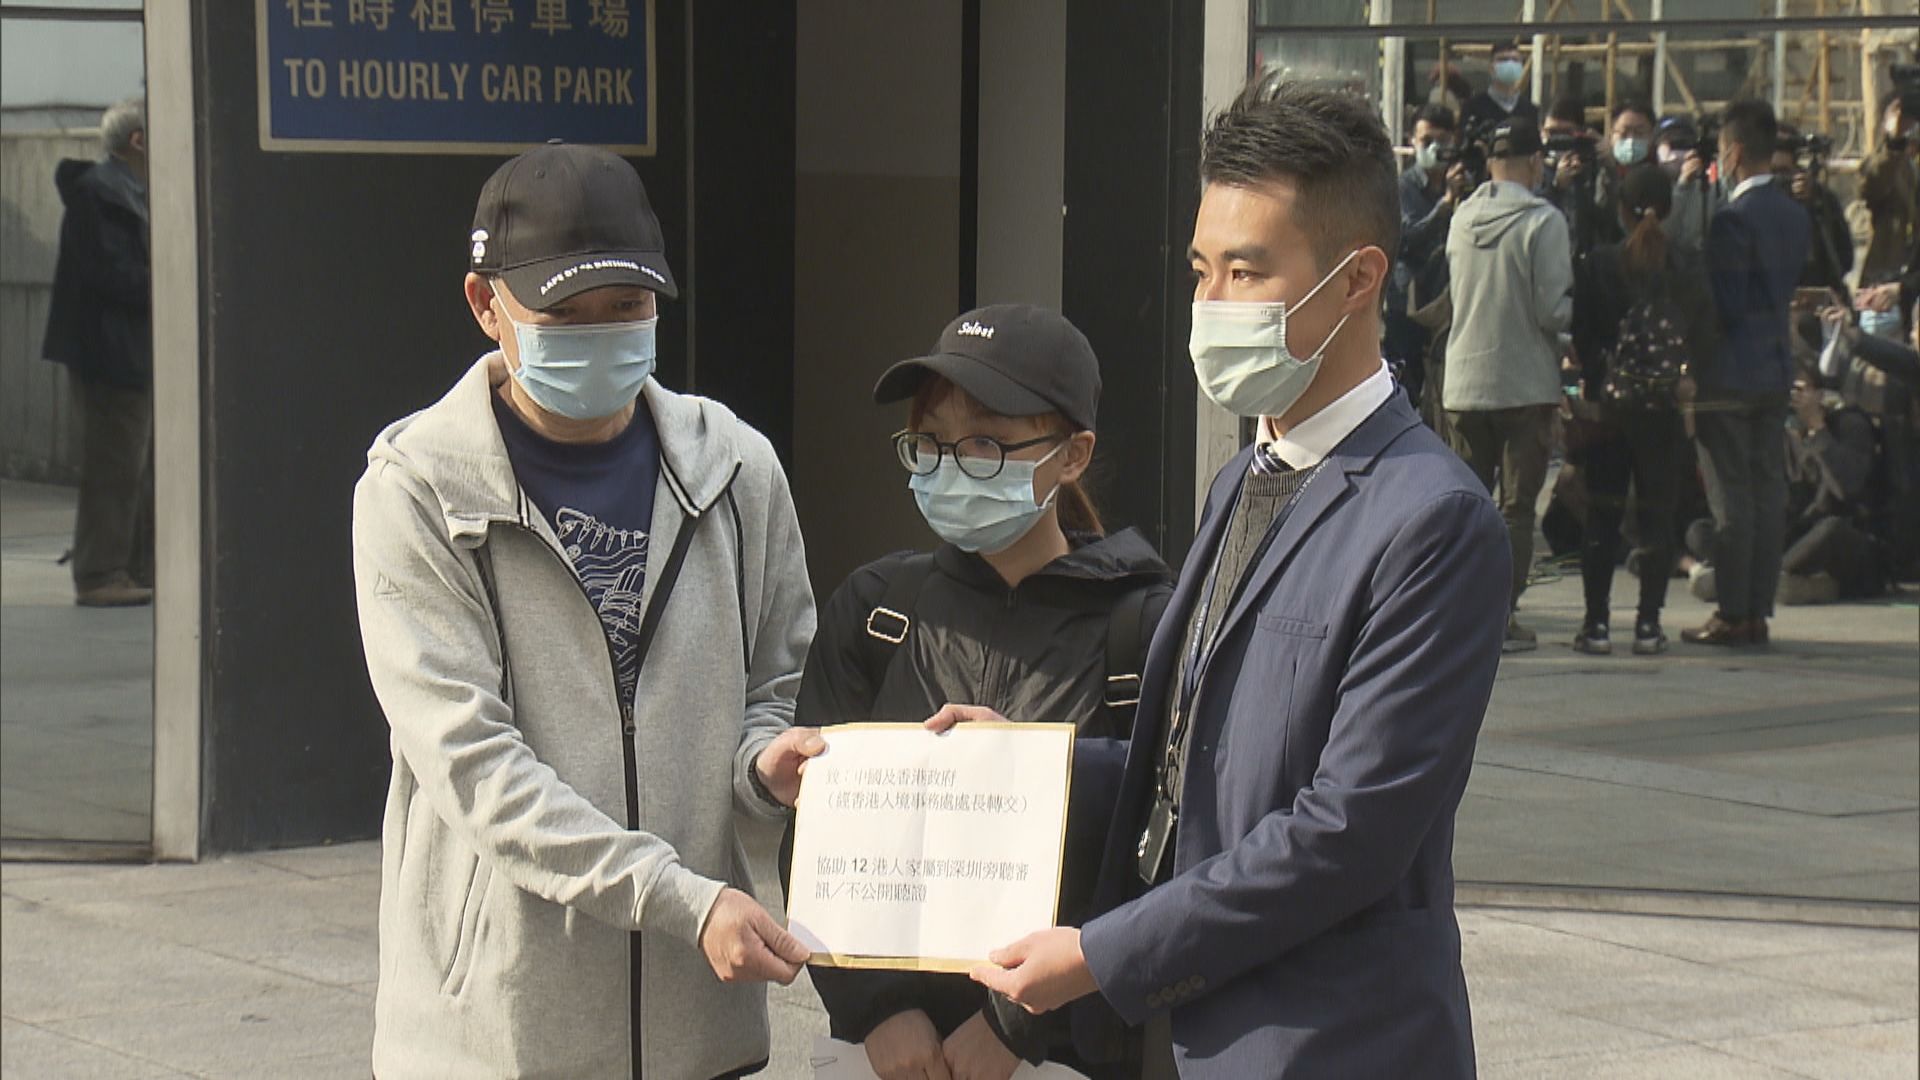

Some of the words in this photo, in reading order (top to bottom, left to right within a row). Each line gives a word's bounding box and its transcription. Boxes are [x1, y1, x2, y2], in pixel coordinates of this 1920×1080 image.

[284, 58, 327, 98] TO
[339, 60, 469, 101] HOURLY
[481, 64, 543, 103] CAR
[554, 66, 634, 106] PARK
[817, 855, 846, 876] 協助
[851, 858, 868, 873] 12
